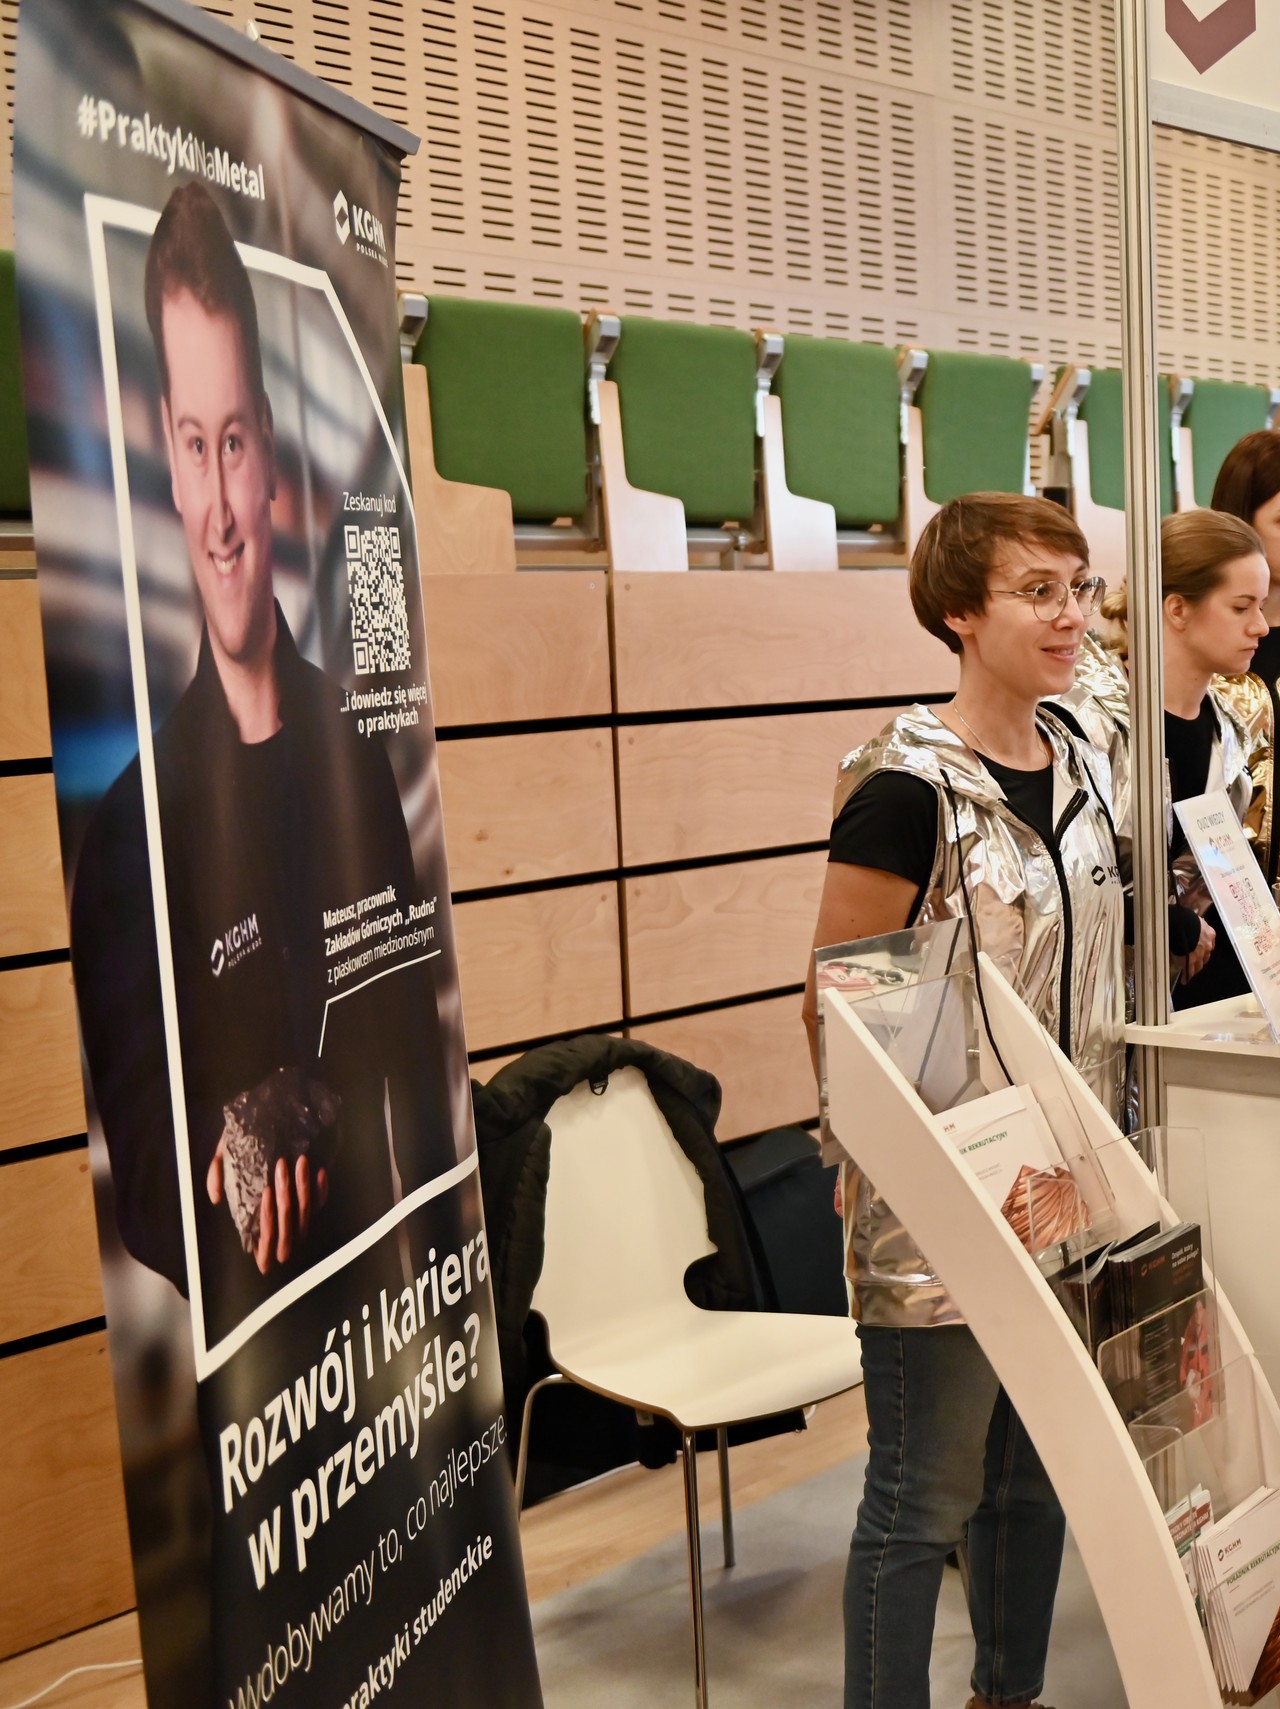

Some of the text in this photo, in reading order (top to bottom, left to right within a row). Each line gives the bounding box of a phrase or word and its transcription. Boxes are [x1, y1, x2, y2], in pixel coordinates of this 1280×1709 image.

[78, 94, 266, 201] #PraktykiNaMetal
[353, 204, 387, 253] KGHM
[343, 491, 397, 517] Zeskanuj kod
[351, 686, 393, 710] dowiedz
[394, 685, 407, 708] się
[407, 681, 428, 706] więcej
[358, 706, 419, 738] o praktykach
[323, 885, 397, 930] Mateusz, pracownik
[225, 913, 259, 956] KGHM
[324, 926, 361, 957] Zakładów
[361, 908, 403, 940] Górniczych
[327, 926, 434, 986] z piaskowcem miedzionośnym
[968, 1130, 1008, 1151] REKRUTACYJNY
[219, 1229, 490, 1513] Rozwój i kariera
[248, 1312, 481, 1591] w przemyśle?
[378, 1528, 404, 1573] to,
[406, 1496, 428, 1540] co
[429, 1414, 508, 1515] najlepsze.
[1225, 1538, 1242, 1555] KGHM
[341, 1535, 493, 1709] raktyki studenckie
